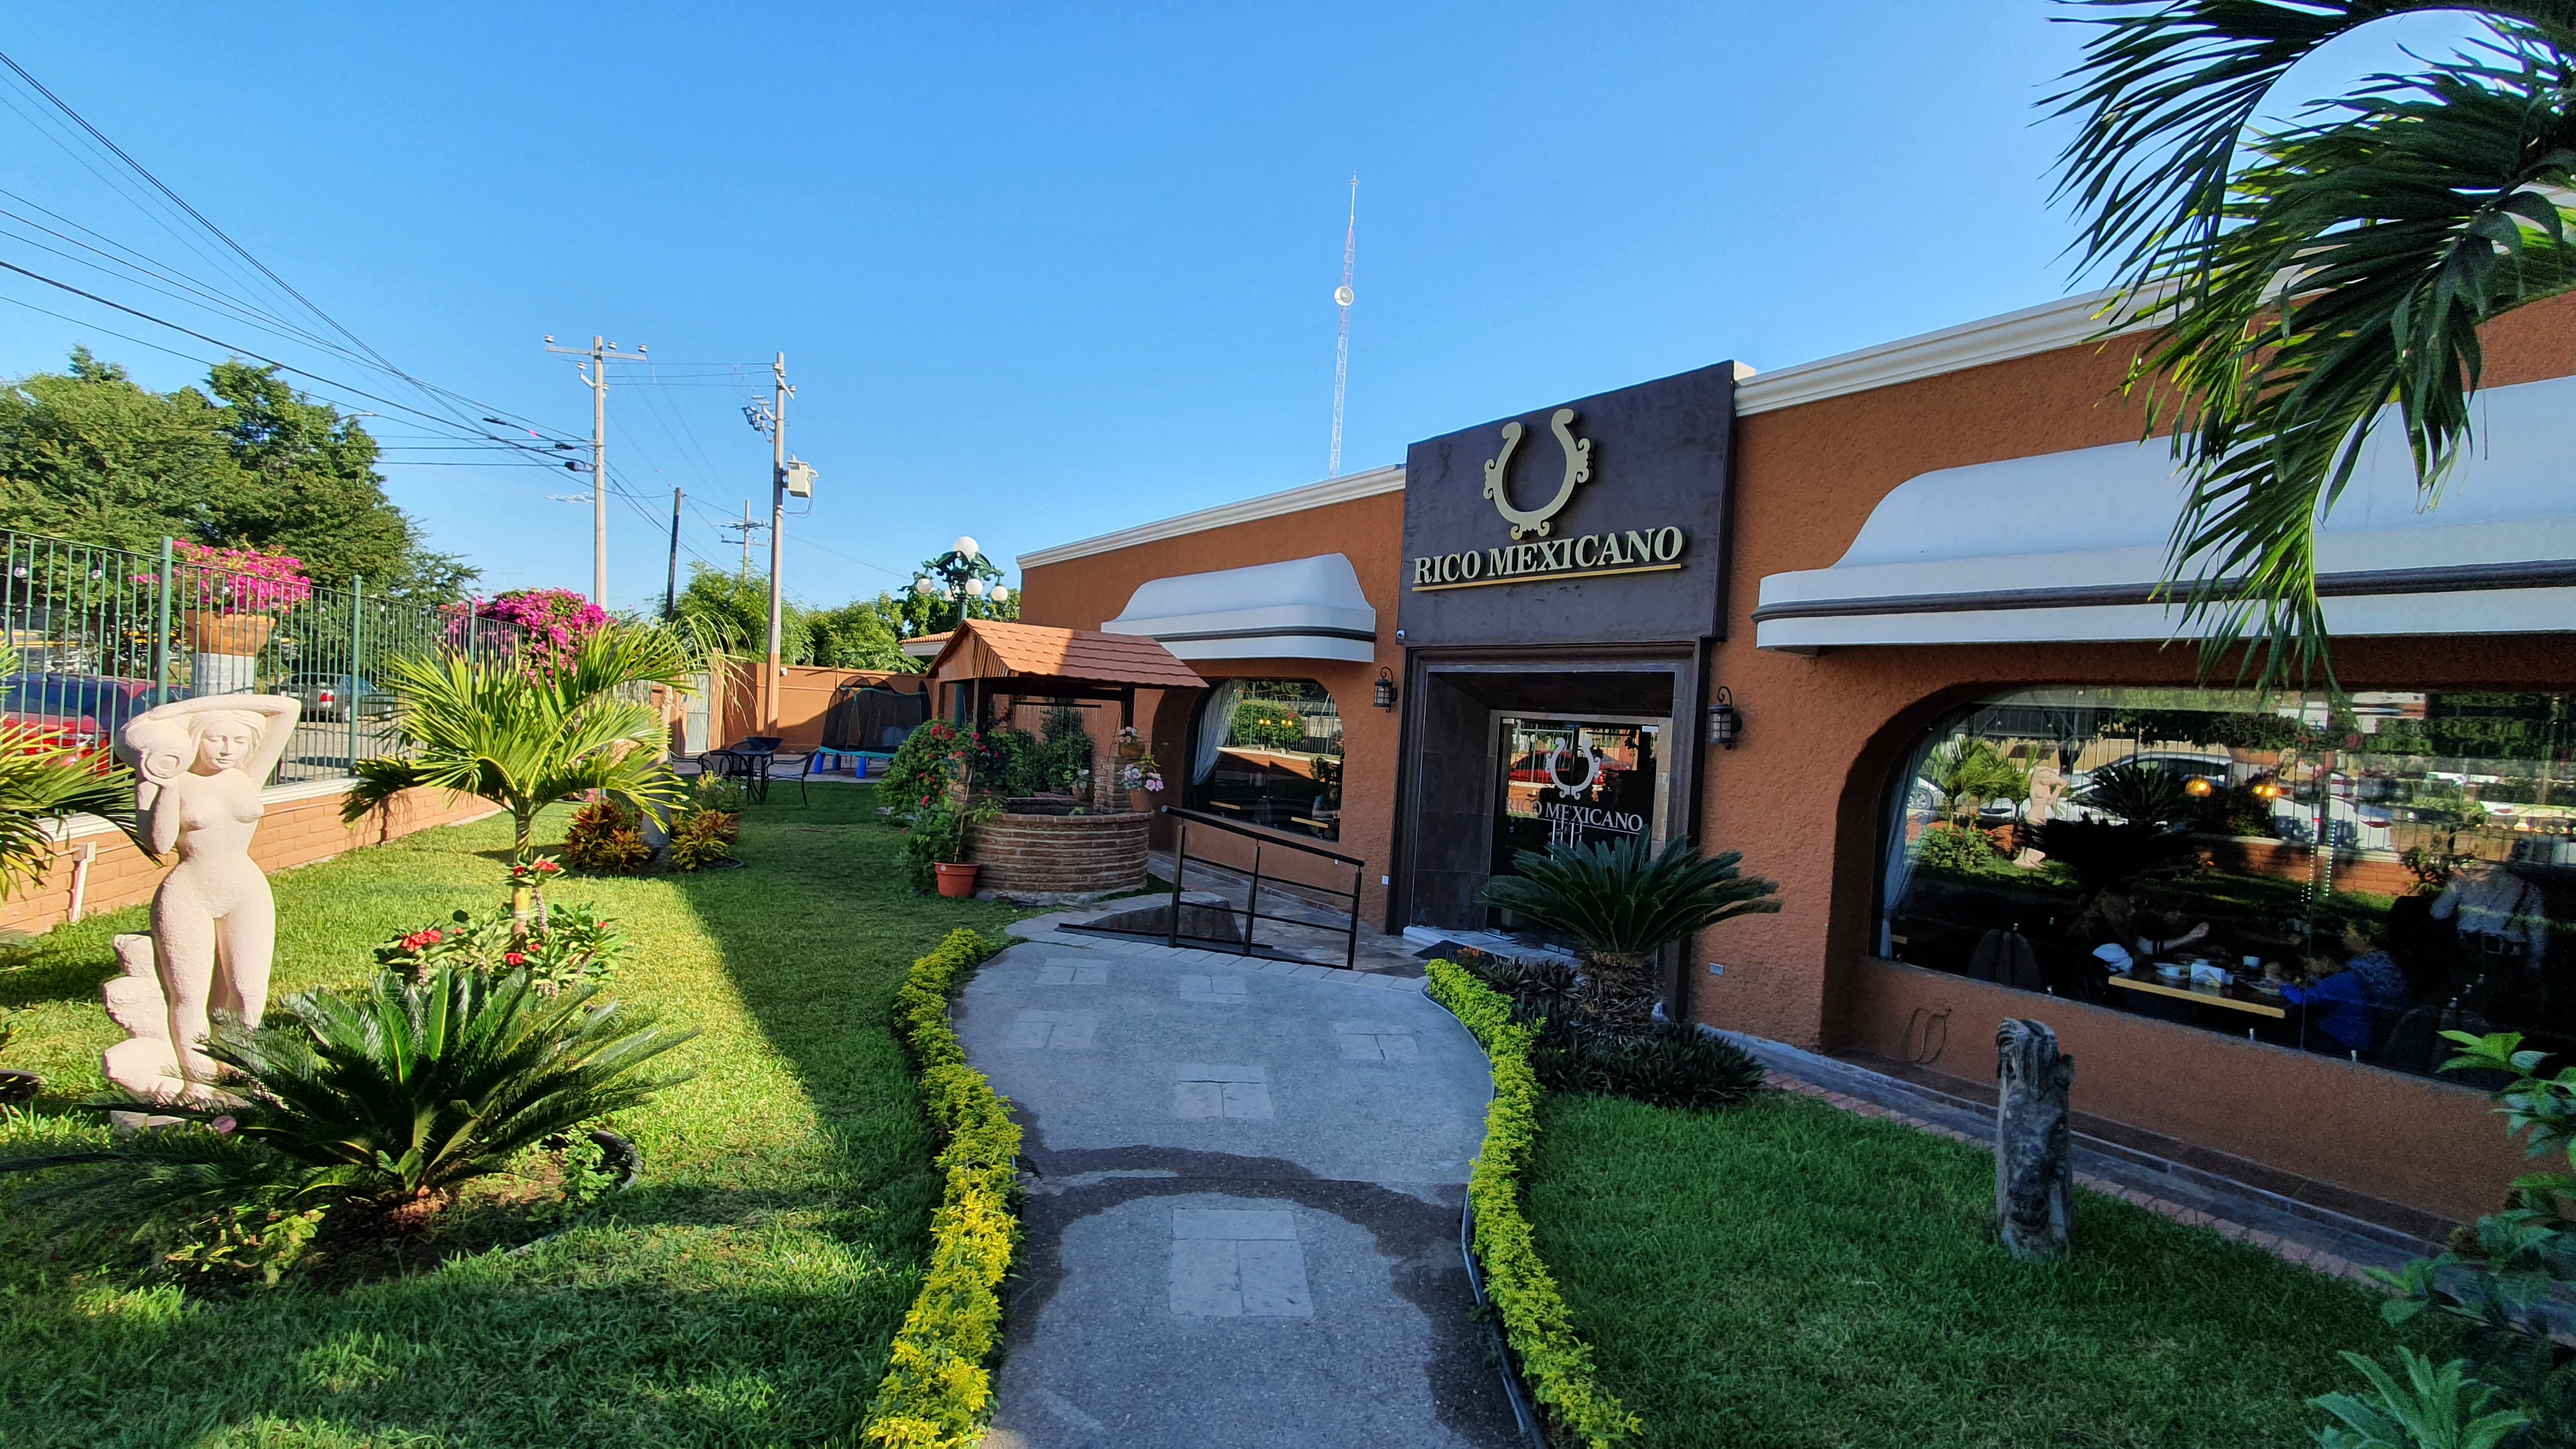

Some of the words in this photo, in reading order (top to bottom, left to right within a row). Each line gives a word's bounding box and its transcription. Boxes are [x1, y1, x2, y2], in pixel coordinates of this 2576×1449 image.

[1413, 550, 1481, 584] RICO
[1487, 526, 1683, 576] MEXICANO
[1505, 797, 1542, 816] RICO
[1545, 802, 1643, 831] MEXICANO
